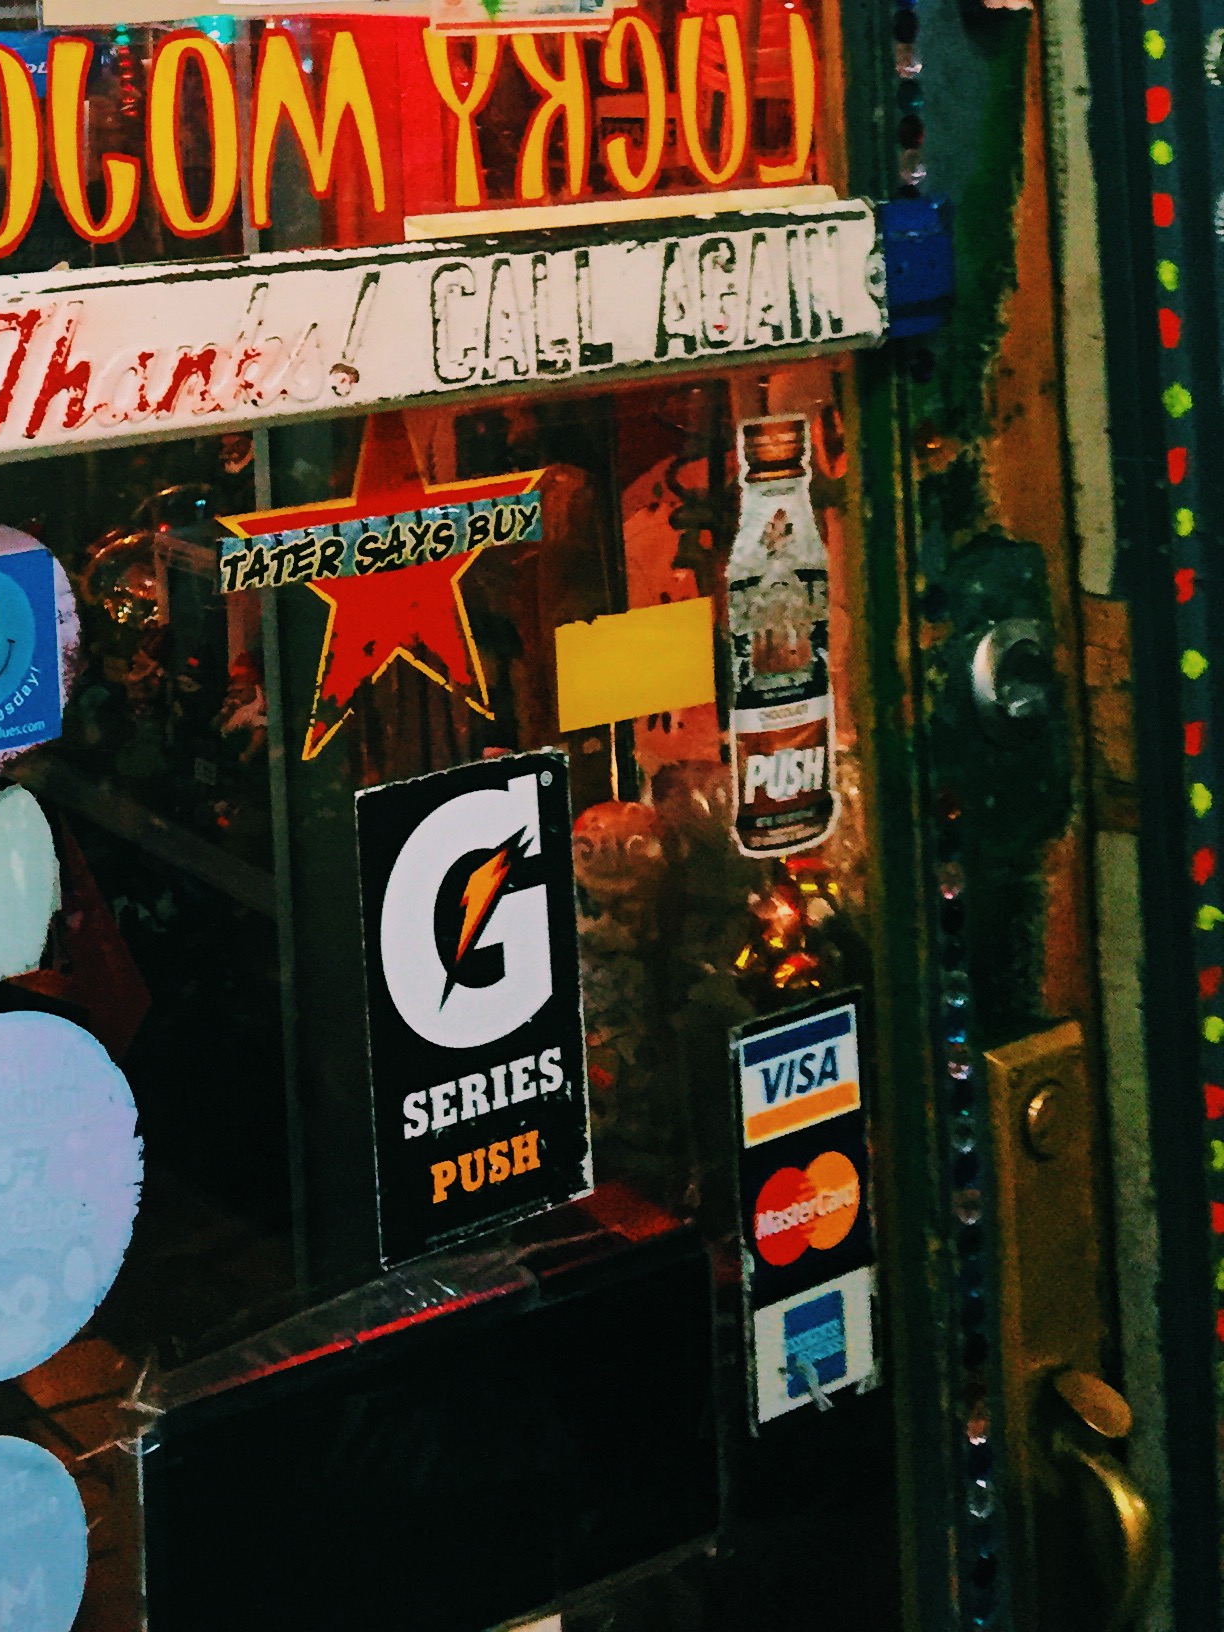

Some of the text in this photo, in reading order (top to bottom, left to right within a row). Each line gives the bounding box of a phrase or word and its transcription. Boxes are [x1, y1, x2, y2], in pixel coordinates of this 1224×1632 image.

[430, 250, 615, 384] CALL
[653, 224, 845, 360] AGAIN
[221, 501, 541, 593] TATER SAYS BUY
[744, 745, 828, 806] PUSH
[403, 1046, 563, 1140] SERIES
[759, 1044, 840, 1105] VISA
[430, 1130, 540, 1204] PUSH
[755, 1174, 861, 1241] MasterCard
